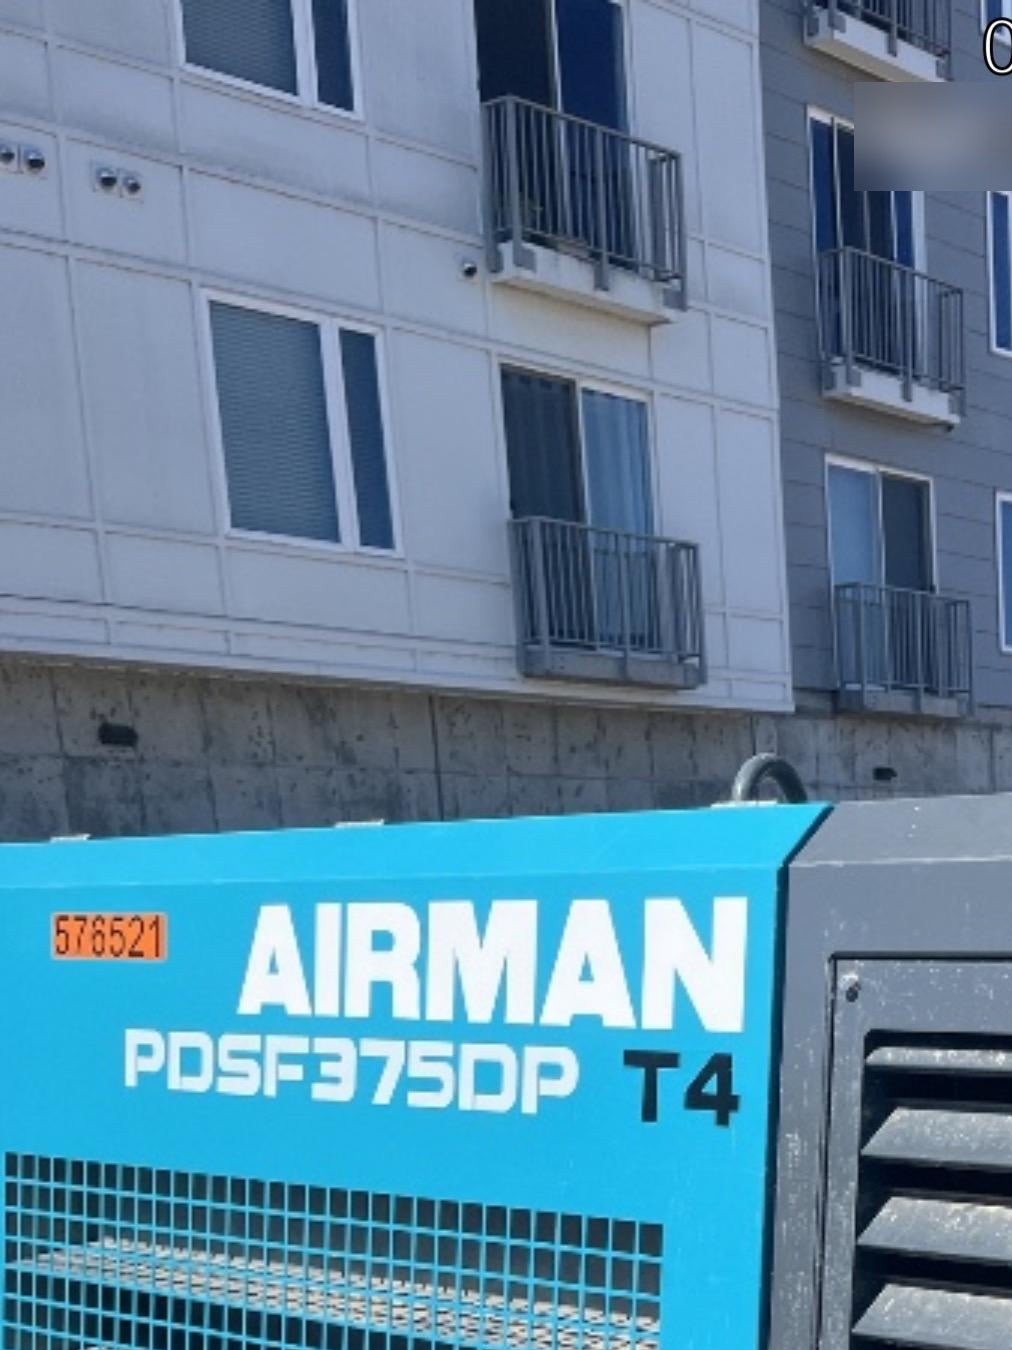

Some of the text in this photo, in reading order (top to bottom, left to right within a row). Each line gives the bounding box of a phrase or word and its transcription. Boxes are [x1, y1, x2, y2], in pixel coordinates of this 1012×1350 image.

[54, 914, 163, 960] 576521
[236, 897, 748, 1032] AIRMAN
[124, 1028, 741, 1127] PDSF375DP T4
